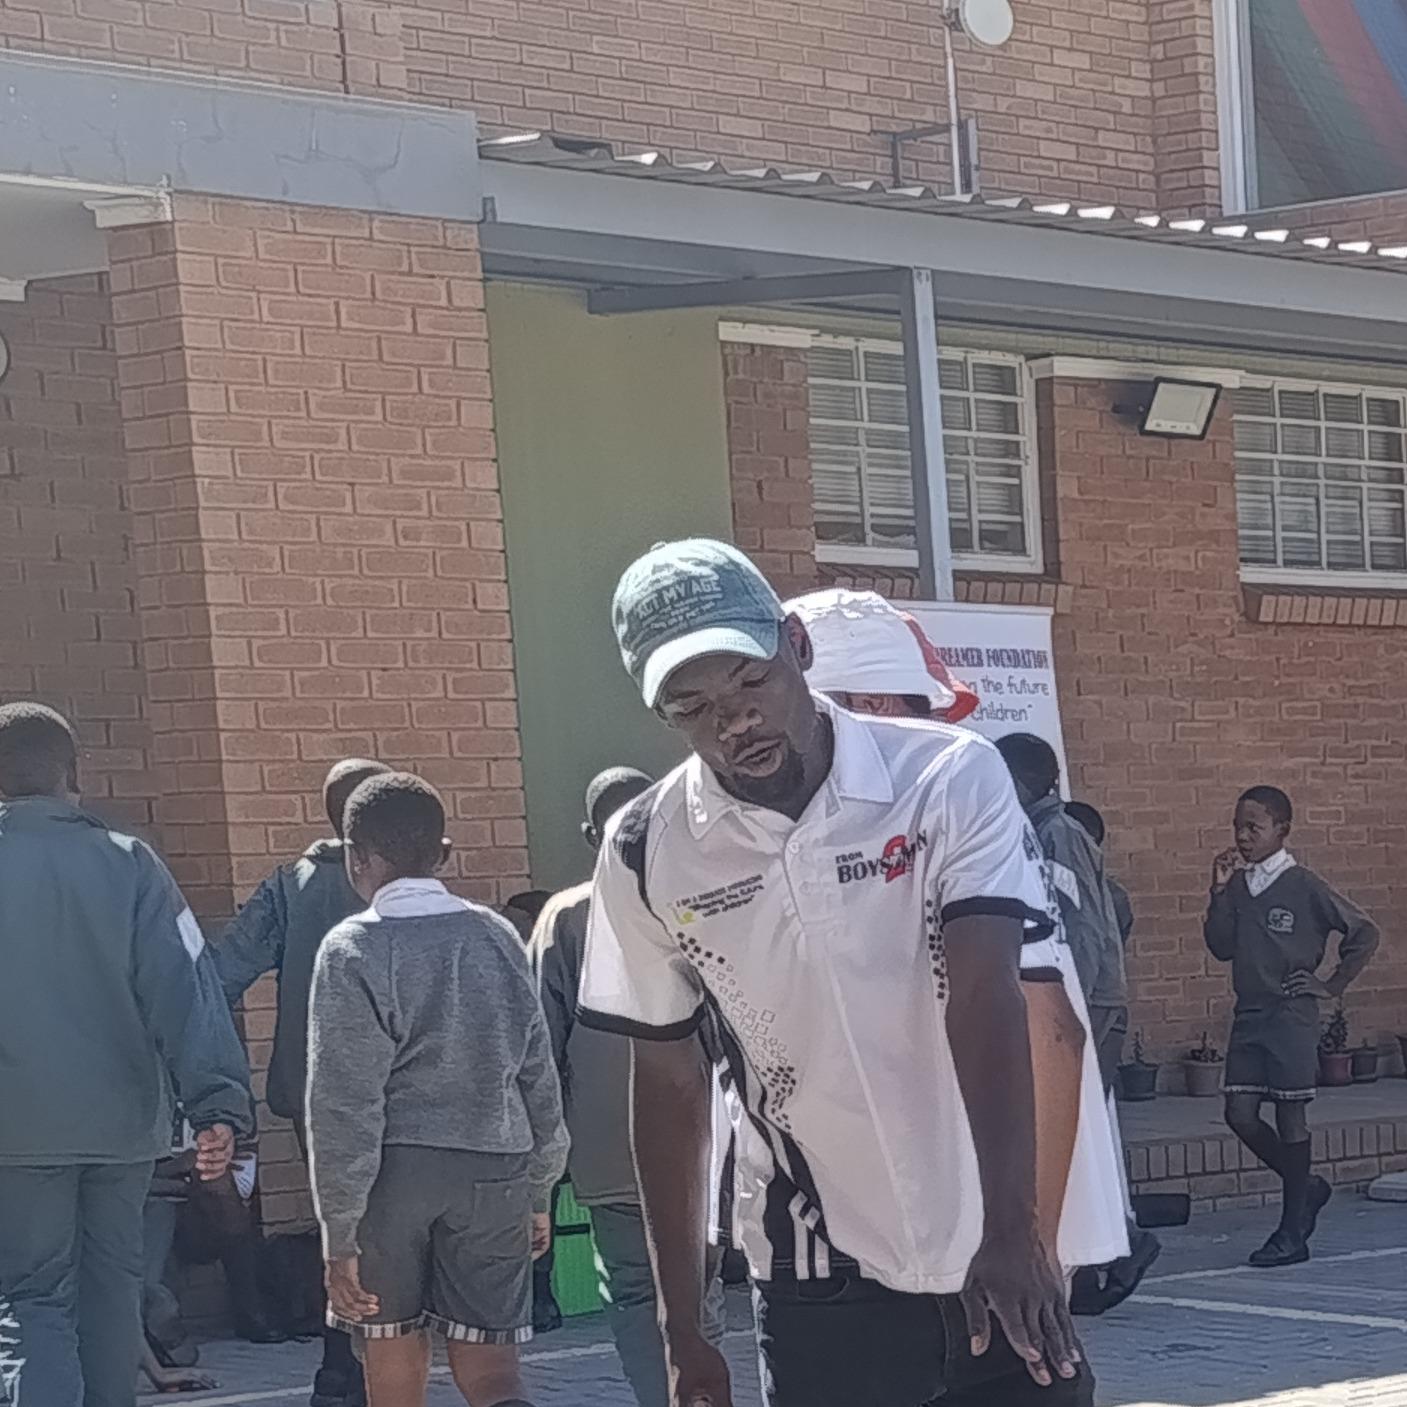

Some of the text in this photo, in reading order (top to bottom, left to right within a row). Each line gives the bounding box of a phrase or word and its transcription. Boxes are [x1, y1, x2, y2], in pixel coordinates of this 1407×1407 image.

[663, 582, 687, 604] MY
[692, 576, 722, 594] AGE
[981, 675, 1005, 695] the
[1007, 675, 1050, 696] future
[835, 850, 864, 865] FROM
